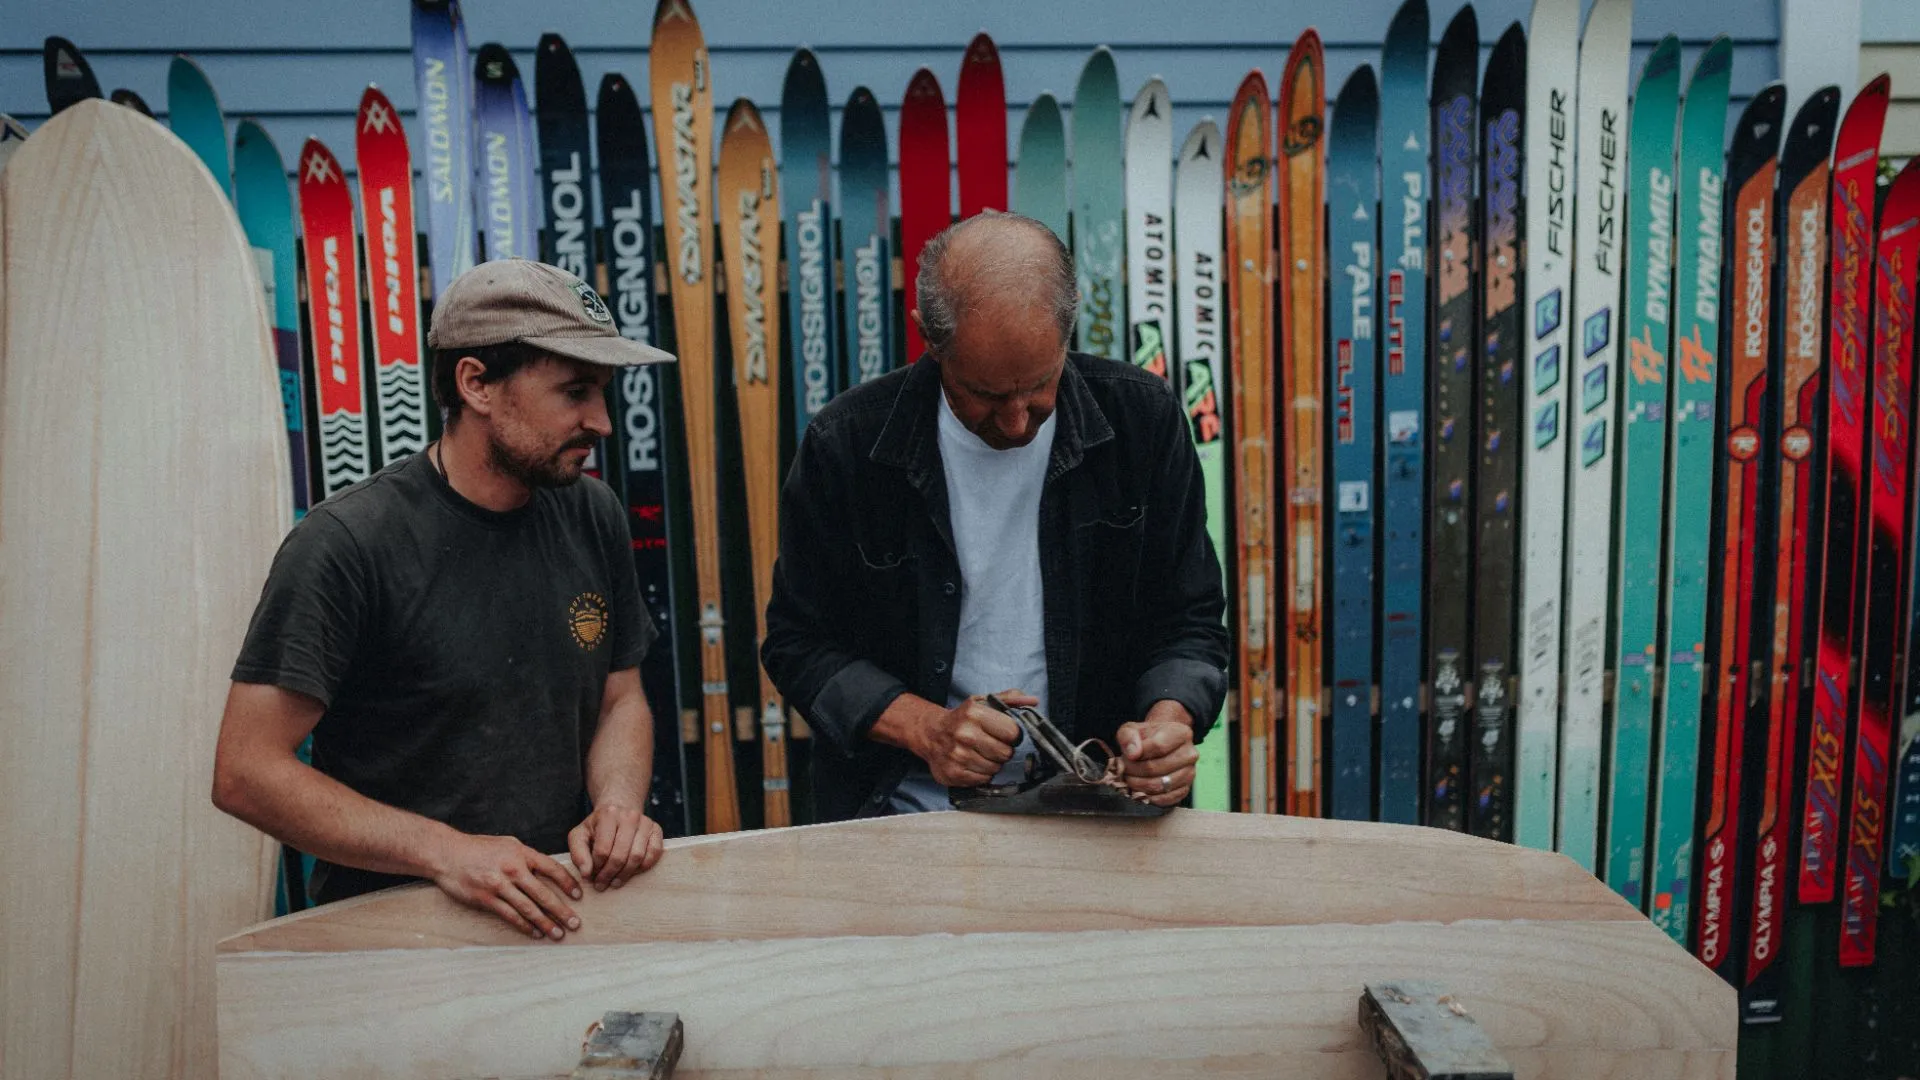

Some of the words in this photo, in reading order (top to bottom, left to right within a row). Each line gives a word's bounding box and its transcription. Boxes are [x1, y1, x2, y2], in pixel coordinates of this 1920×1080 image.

[424, 57, 454, 204] SALOMON
[485, 131, 514, 261] ALOMON
[671, 82, 703, 284] DYNASTAR
[1548, 87, 1567, 258] FISCHER
[1596, 107, 1618, 277] FISCHER
[738, 189, 768, 385] DYNASTAR
[1144, 212, 1165, 314] ATOMIC
[1345, 241, 1371, 340] PALE
[1398, 171, 1422, 270] PALE
[1646, 167, 1671, 324] DYNAMIC
[1696, 167, 1721, 324] DYNAMIC
[1745, 198, 1765, 358] ROSSIGNOL
[1798, 199, 1819, 358] ROSSIGNOL
[1841, 178, 1859, 371] DYNASTAR
[612, 189, 658, 471] ROSIGNOL
[797, 199, 828, 415] ROSSIGNOL
[1195, 251, 1215, 354] ATOMIC
[1389, 269, 1404, 376] ELITE
[1883, 245, 1902, 440] DYNASTAR
[1337, 338, 1354, 444] ELITE
[1702, 865, 1724, 962] OLYMPIA
[1754, 864, 1776, 960] OLYMPIA
